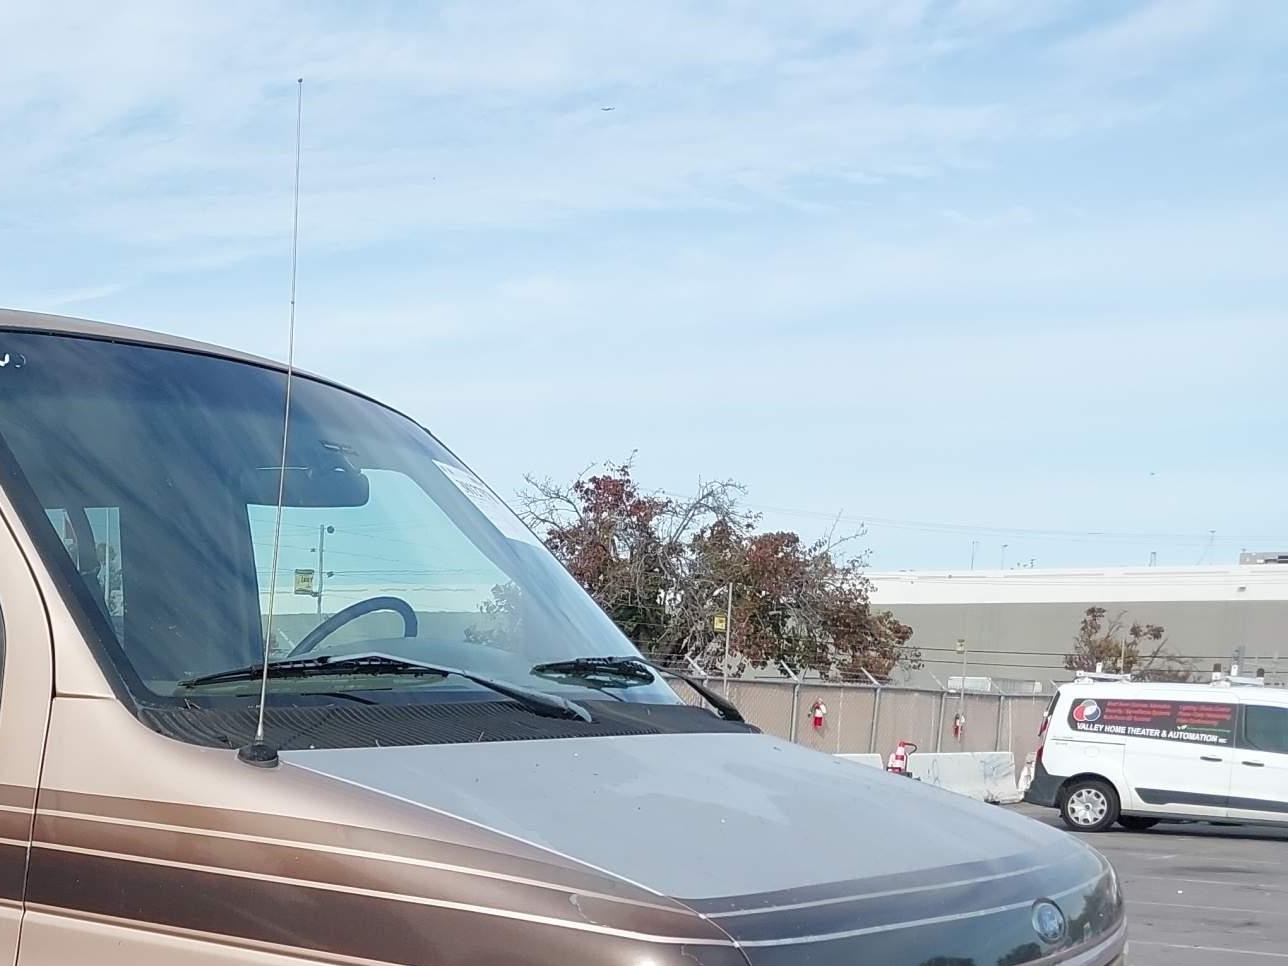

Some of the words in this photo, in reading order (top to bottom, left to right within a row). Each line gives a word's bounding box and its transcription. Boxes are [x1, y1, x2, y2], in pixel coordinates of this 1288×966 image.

[1077, 722, 1104, 732] VALLEY
[1104, 725, 1126, 734] HOME
[1127, 727, 1160, 737] THEATER
[1161, 730, 1168, 738] &
[1168, 731, 1218, 743] AUTOMATION
